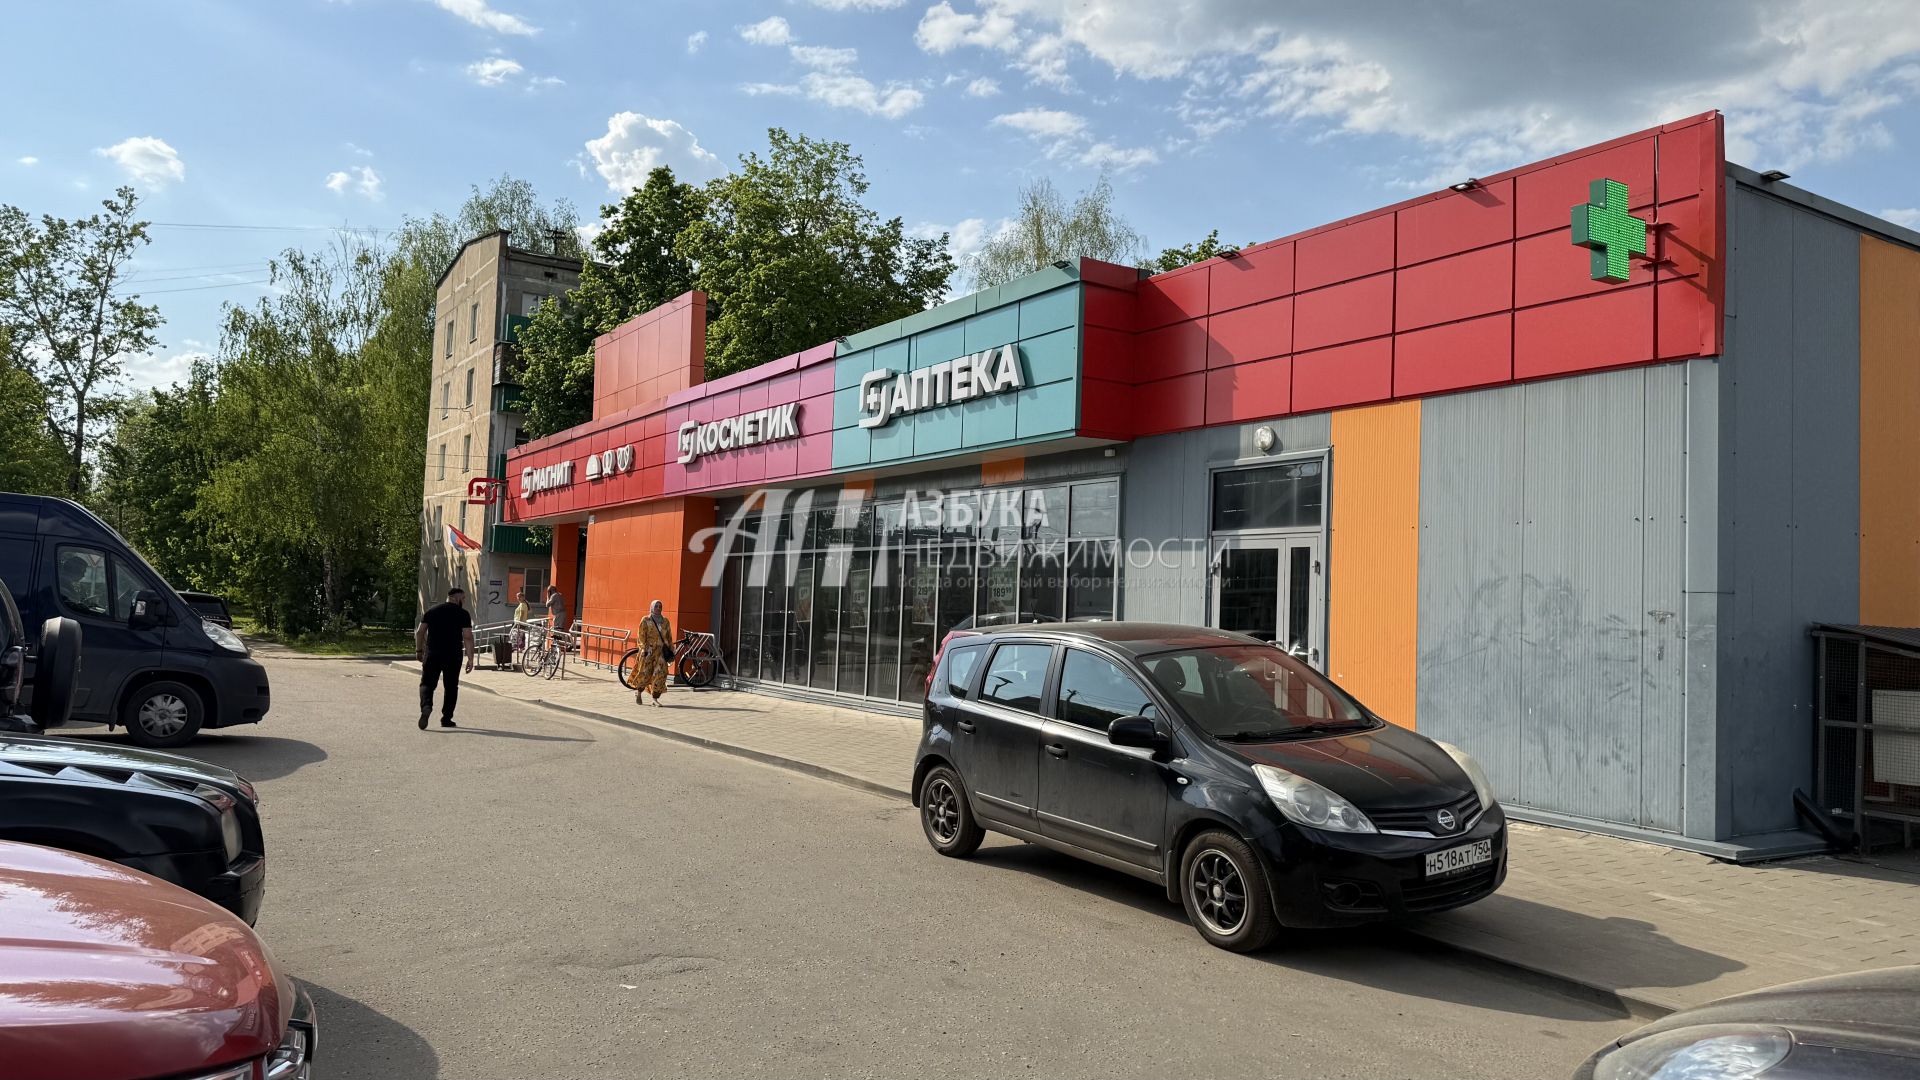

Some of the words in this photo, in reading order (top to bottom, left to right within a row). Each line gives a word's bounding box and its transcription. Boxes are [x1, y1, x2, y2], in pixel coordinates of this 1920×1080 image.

[890, 343, 1025, 414] АПТЕКА
[696, 402, 800, 455] КОСМЕТИК
[532, 460, 574, 492] МАГНИТ
[488, 591, 501, 605] 2
